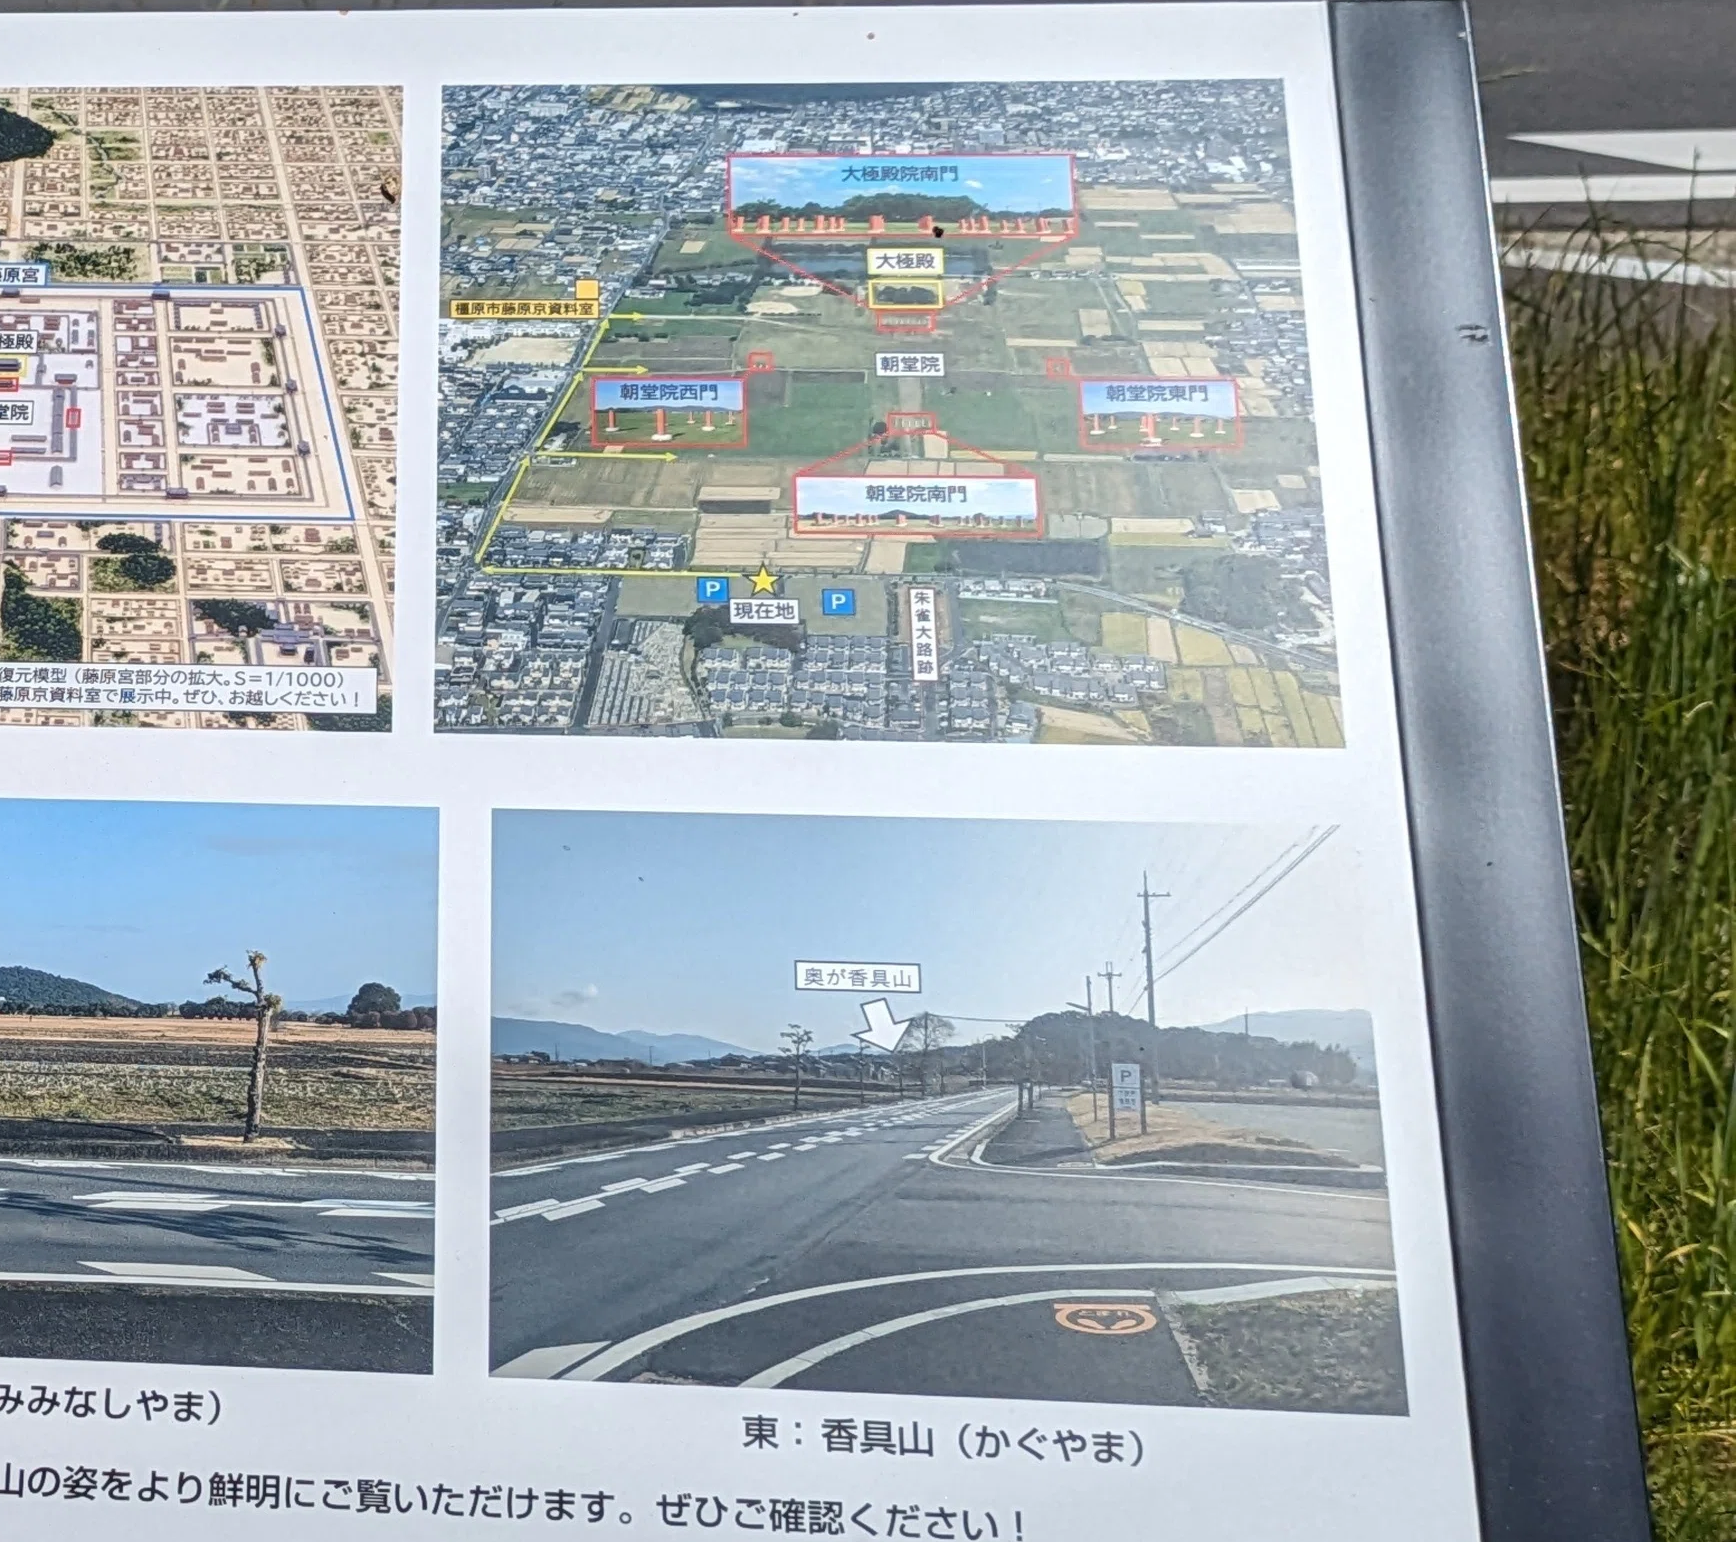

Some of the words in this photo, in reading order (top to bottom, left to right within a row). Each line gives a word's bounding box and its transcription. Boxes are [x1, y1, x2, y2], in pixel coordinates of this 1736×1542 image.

[842, 166, 958, 182] 大極殿院南門
[875, 252, 937, 272] 大極殿
[455, 303, 593, 315] 橿原市藤原京資料室
[880, 356, 940, 372] 朝堂院
[620, 383, 717, 400] 朝堂院西門
[1106, 385, 1208, 402] 朝堂院東門
[866, 485, 966, 502] 朝堂院南門
[705, 580, 721, 600] P
[734, 602, 795, 619] 現在地
[831, 592, 847, 612] P
[914, 592, 933, 674] 朱雀大路跡
[805, 968, 911, 987] 奥が香具山
[743, 1415, 1142, 1466] 東：香具山（かぐやま）
